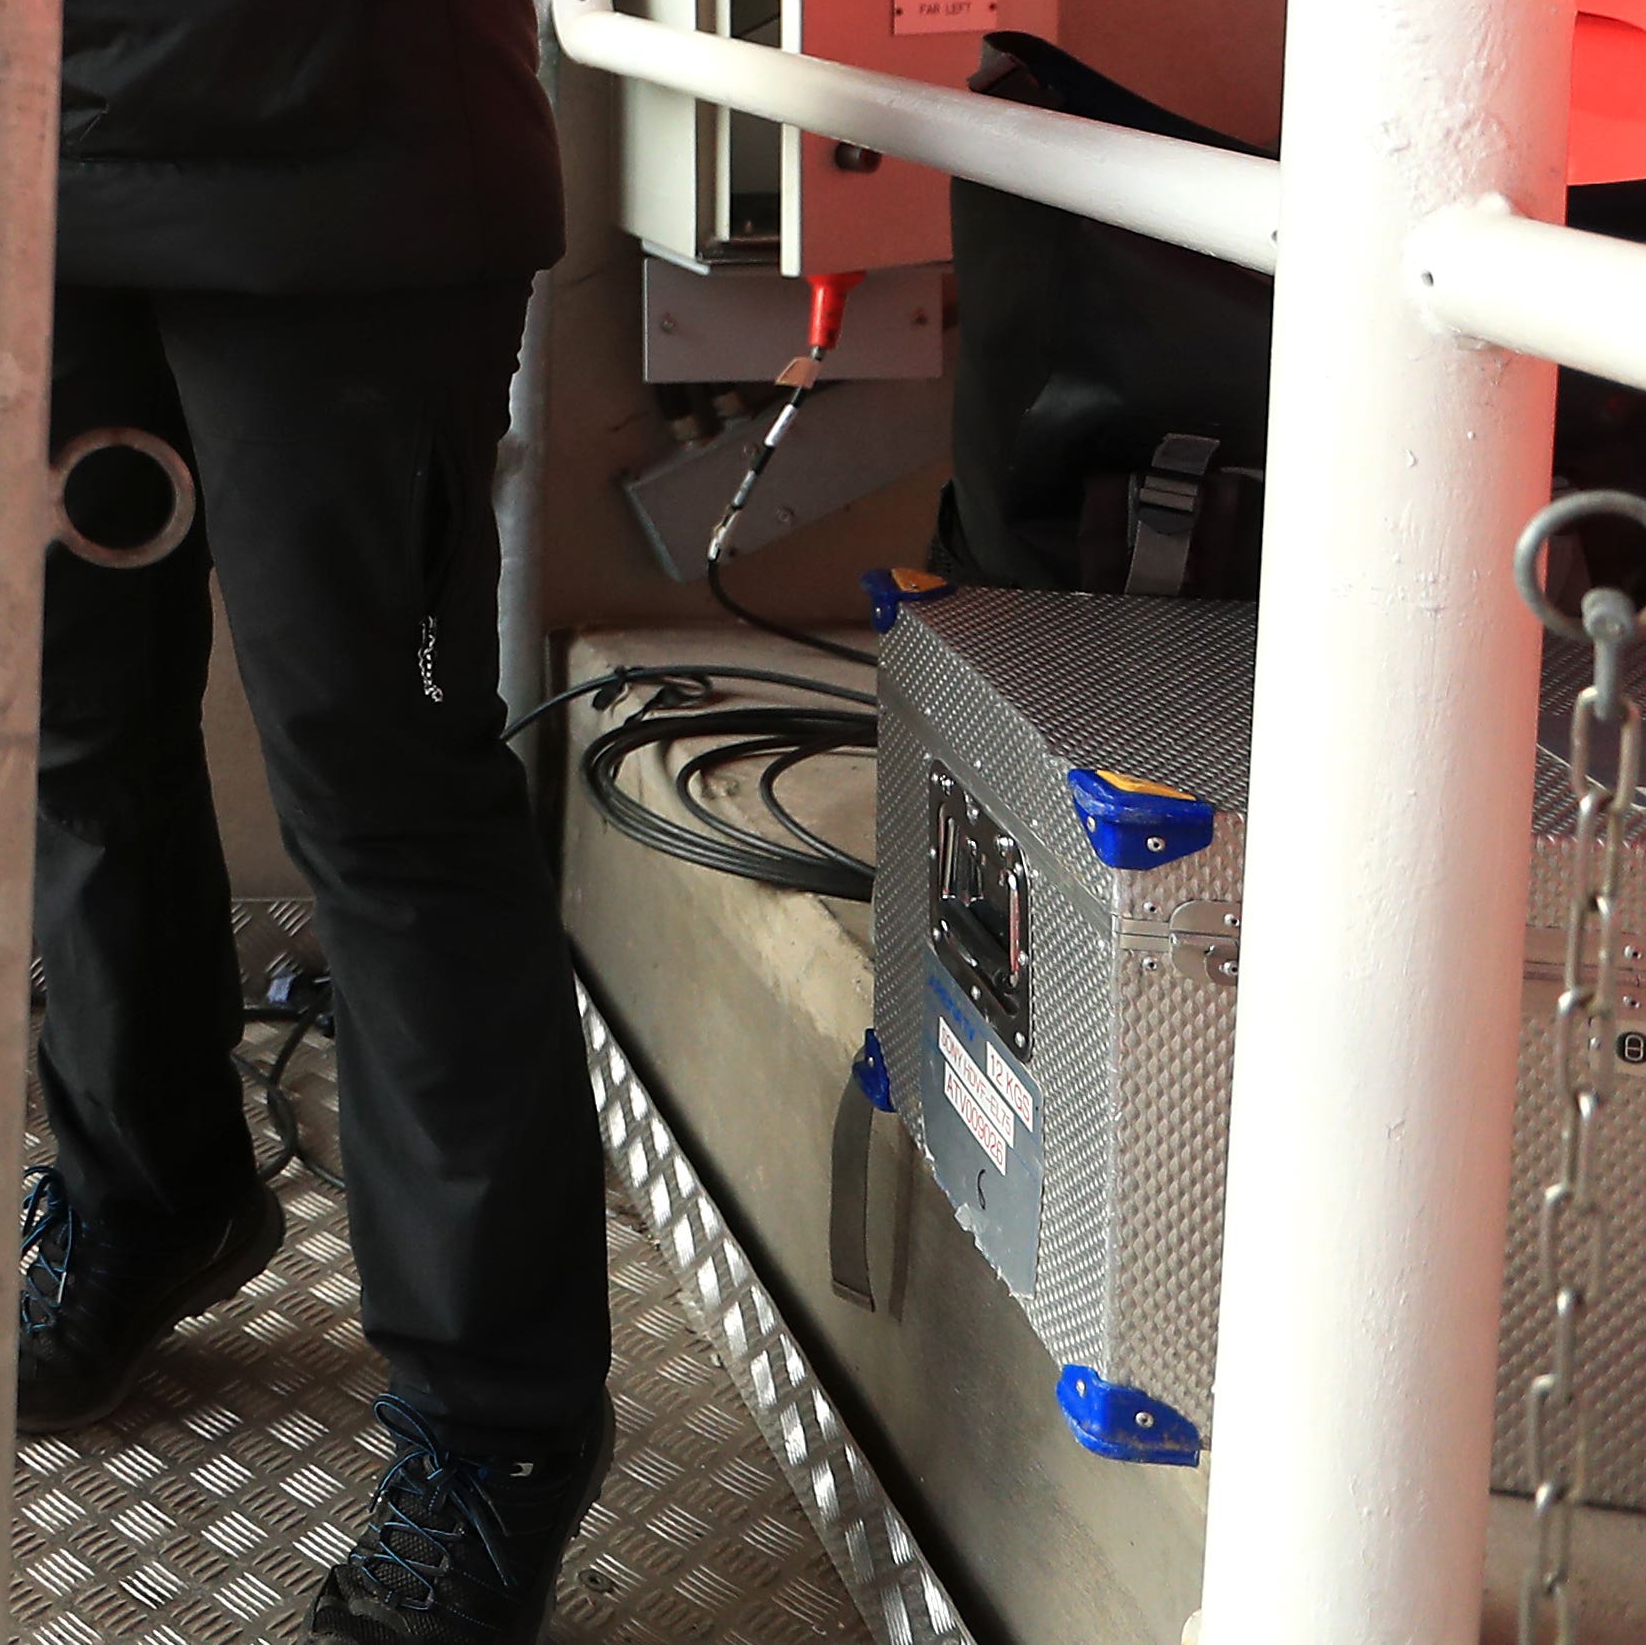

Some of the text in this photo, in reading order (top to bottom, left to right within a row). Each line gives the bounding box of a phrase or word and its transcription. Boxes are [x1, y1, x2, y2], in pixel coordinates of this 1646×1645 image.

[919, 1, 971, 15] FAR LEFT
[940, 1026, 963, 1068] SONY
[989, 1053, 1031, 1123] 12 KGS
[945, 1073, 1005, 1166] ATV009026
